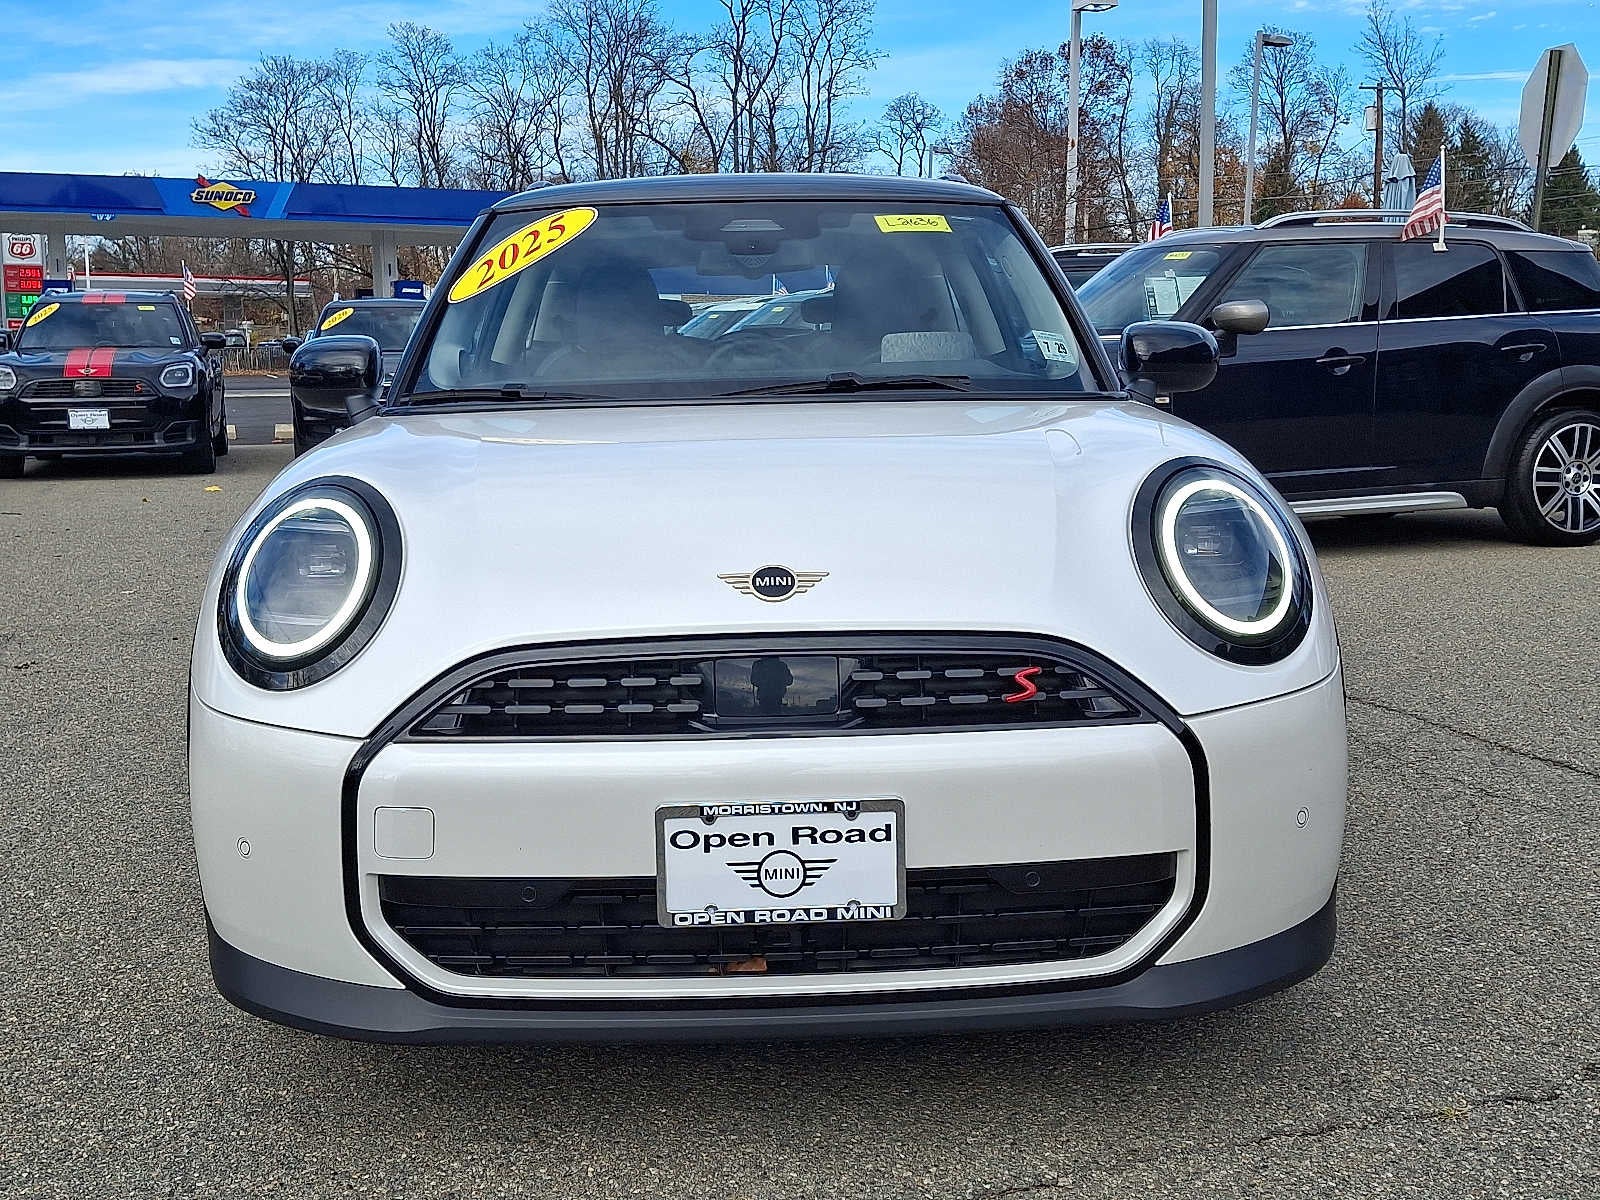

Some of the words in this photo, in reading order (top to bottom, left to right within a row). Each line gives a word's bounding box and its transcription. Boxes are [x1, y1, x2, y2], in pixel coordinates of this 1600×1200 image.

[195, 190, 253, 202] SUNOCO
[12, 243, 31, 254] 66
[476, 214, 566, 290] 2025
[1042, 341, 1050, 352] 7
[1054, 342, 1068, 355] 29
[755, 576, 793, 587] MINI
[1006, 666, 1041, 702] S
[834, 801, 857, 812] NJ
[669, 830, 775, 853] Open
[791, 823, 892, 846] Road
[764, 867, 800, 881] MINI
[674, 911, 745, 926] OPEN
[754, 908, 828, 923] ROAD
[836, 906, 892, 920] MINI
